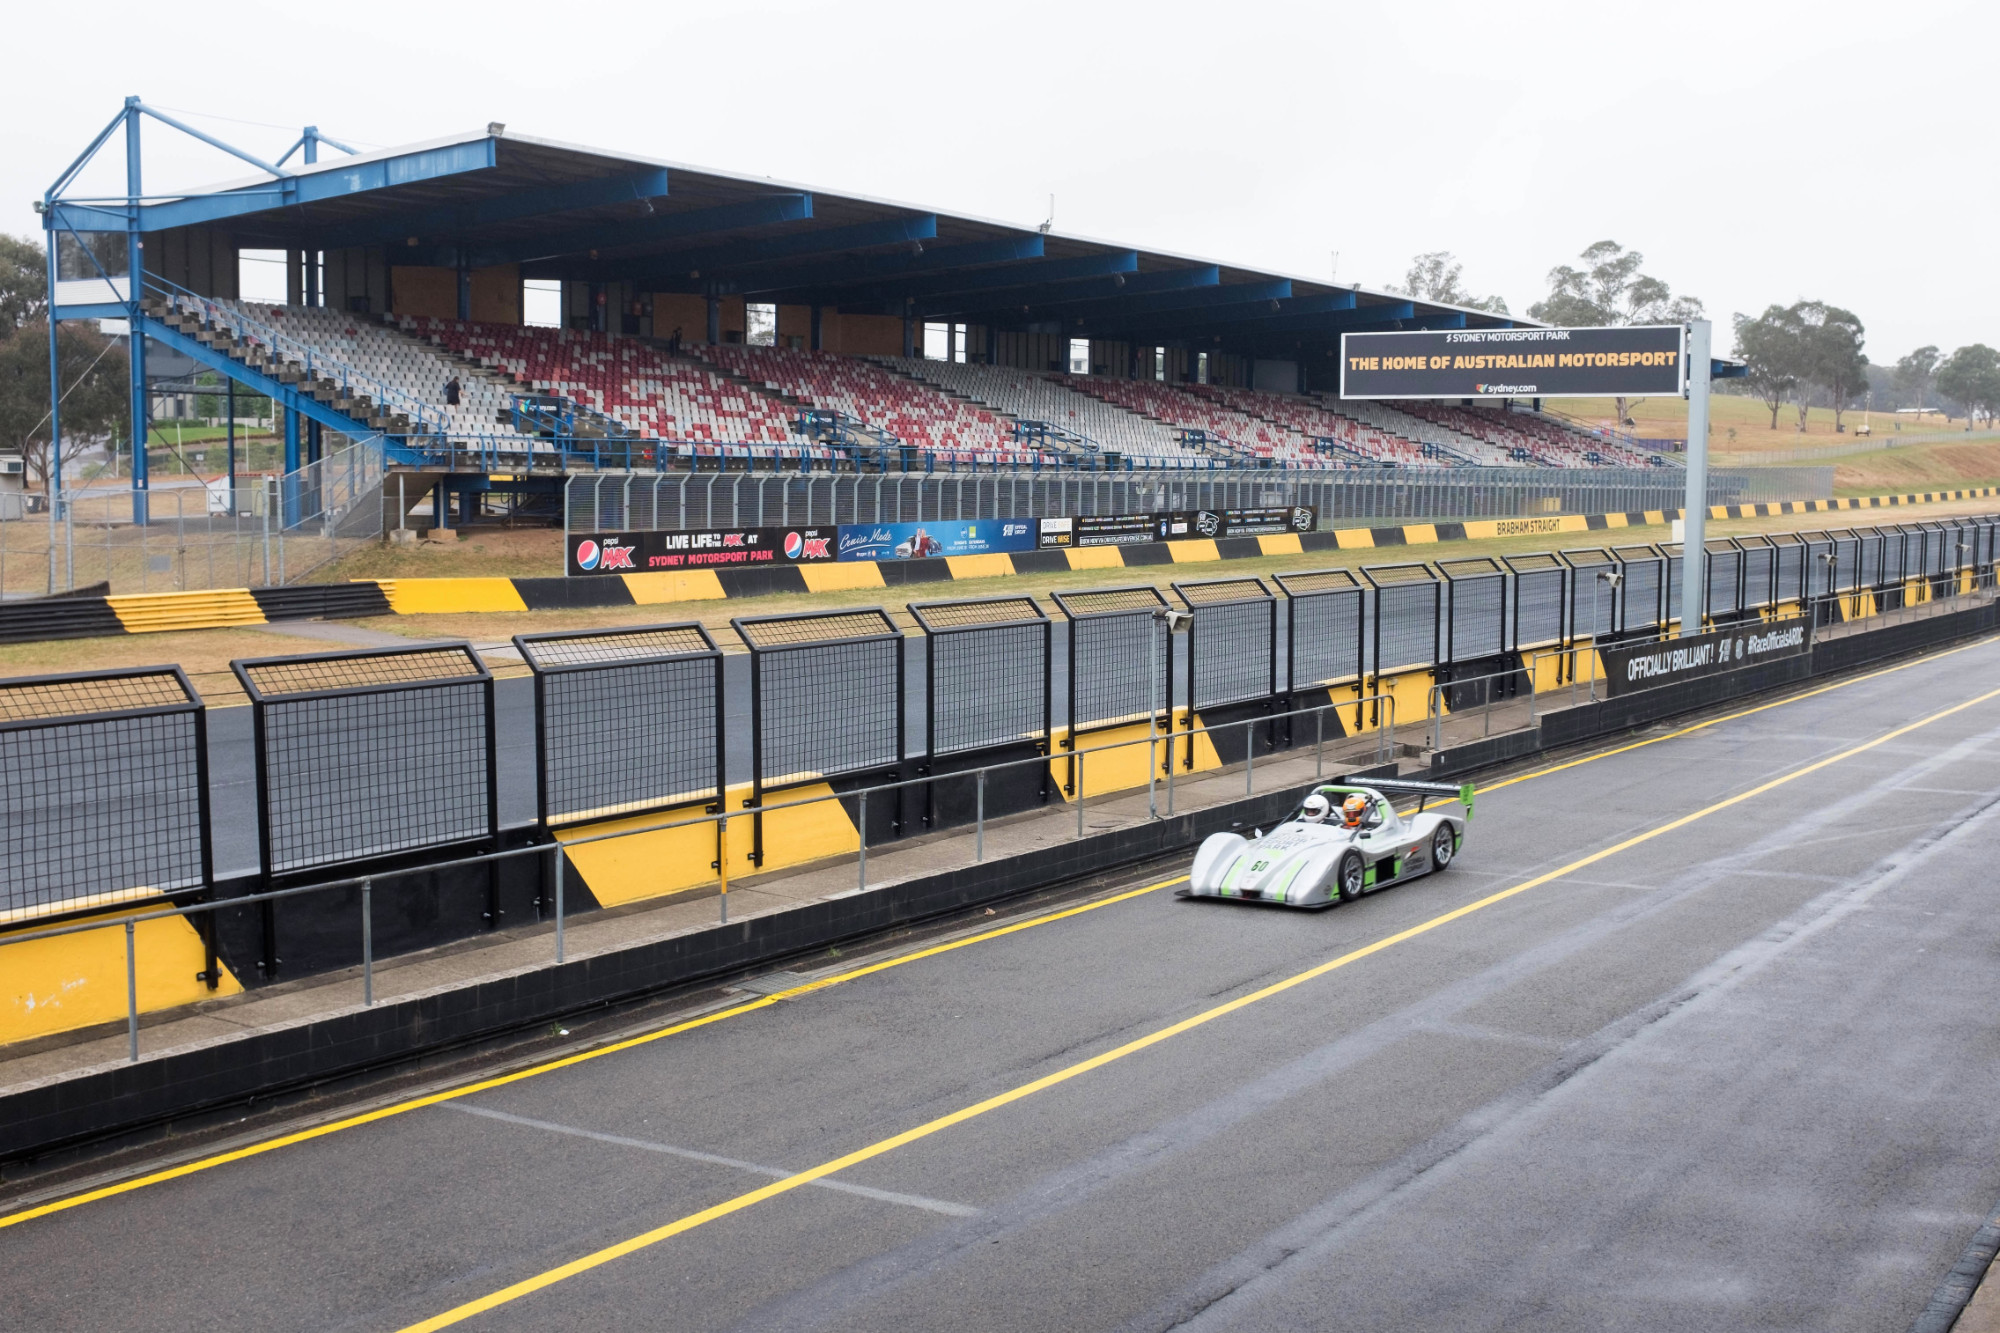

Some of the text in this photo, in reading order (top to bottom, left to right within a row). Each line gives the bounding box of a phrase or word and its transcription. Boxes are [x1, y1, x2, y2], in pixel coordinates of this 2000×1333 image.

[1453, 331, 1570, 343] SYDNEY MOTORSPORT PARK
[1350, 351, 1677, 371] THE HOME OF AUSTRALIAN MOTORSPORT
[1488, 384, 1537, 394] sydney.com
[1042, 521, 1057, 530] DRIVE
[1497, 519, 1560, 535] BRABHAM STRAIGHT
[603, 537, 619, 546] pepsi
[666, 535, 689, 549] LIVE
[691, 533, 712, 548] LIFE
[723, 533, 745, 547] MAX
[747, 534, 758, 544] AT
[805, 530, 818, 538] pepsi
[869, 527, 892, 542] Mode
[1042, 535, 1070, 544] DRIVE WISE
[802, 538, 831, 559] MAX
[601, 546, 636, 570] MAX
[648, 550, 774, 567] SYDNEY MOTORSPORT PARK
[1747, 626, 1804, 655] #RaceOfficialsARDC
[1628, 654, 1671, 682] OFFICIALLY
[1251, 861, 1269, 871] 60
